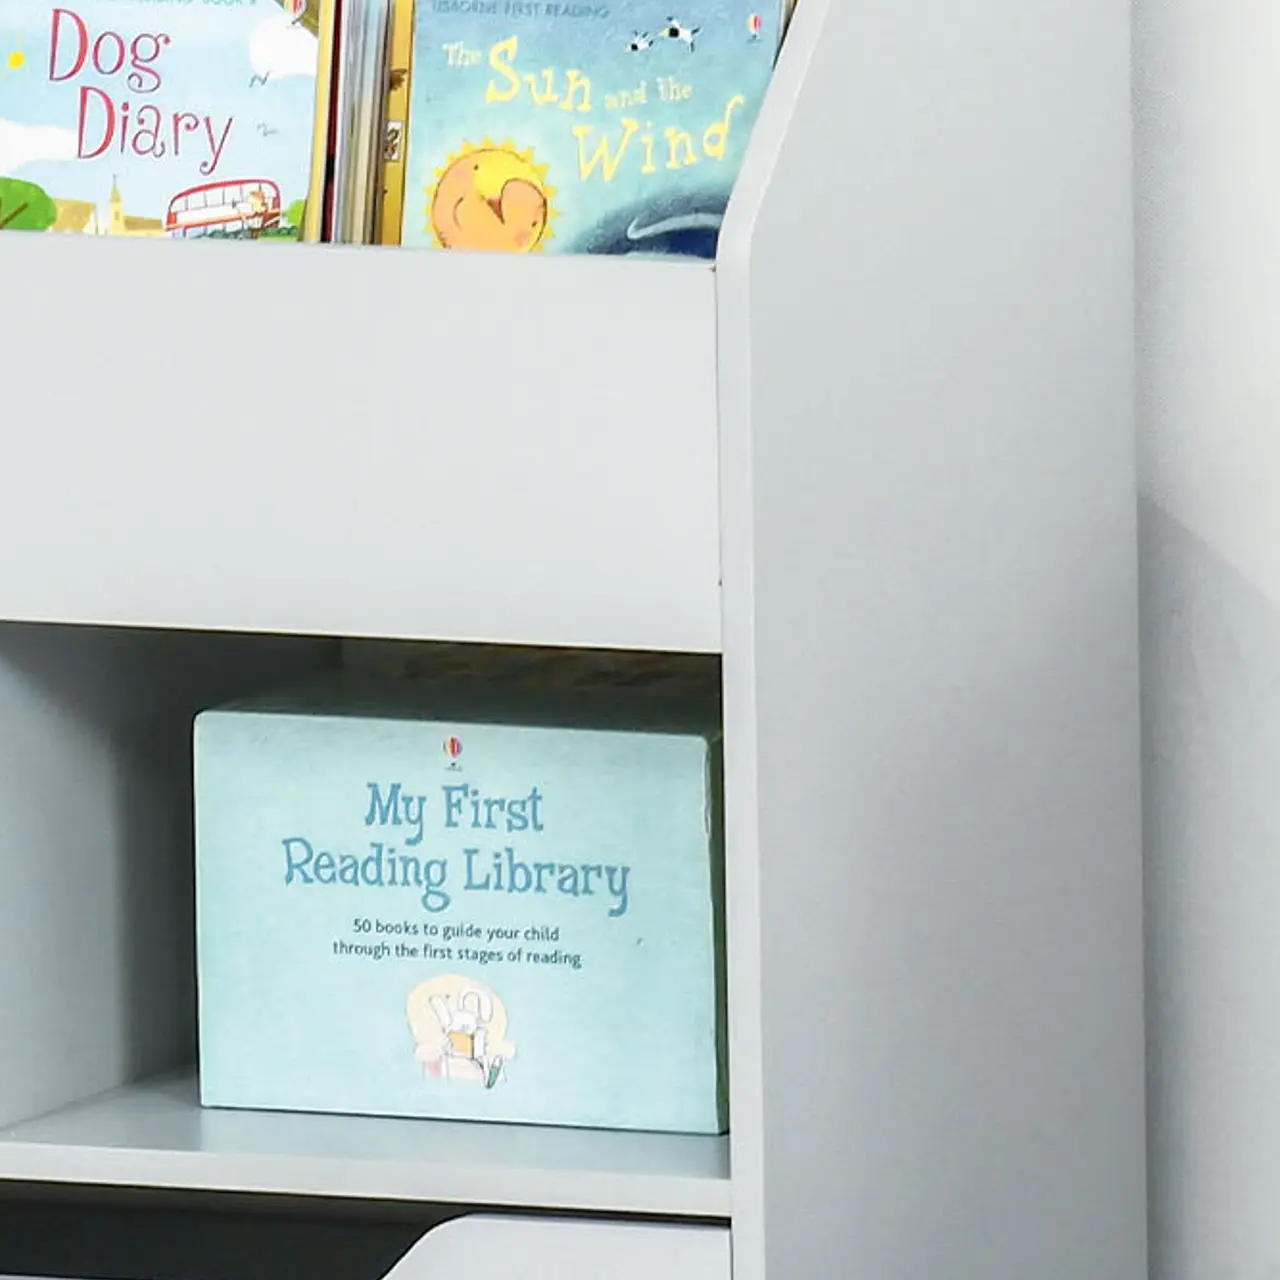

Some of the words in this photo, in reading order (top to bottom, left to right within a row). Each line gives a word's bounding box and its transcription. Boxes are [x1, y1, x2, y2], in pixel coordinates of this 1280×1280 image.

[48, 7, 171, 93] Dog
[441, 40, 483, 66] The
[485, 35, 594, 113] Sun
[604, 81, 647, 111] and
[656, 76, 693, 102] the
[77, 85, 233, 175] Diary
[571, 96, 745, 184] Wind
[363, 782, 428, 847] My
[441, 783, 545, 834] First
[280, 837, 451, 912] Reading
[463, 847, 630, 918] Library
[333, 941, 390, 960] through
[395, 943, 418, 958] the
[423, 944, 453, 959] first
[457, 947, 503, 964] stages
[507, 946, 523, 963] of
[527, 950, 582, 969] reading
[352, 918, 372, 933] 50
[375, 919, 419, 935] books
[423, 924, 439, 935] to
[442, 924, 482, 940] guide
[487, 926, 520, 942] your
[523, 927, 559, 942] child
